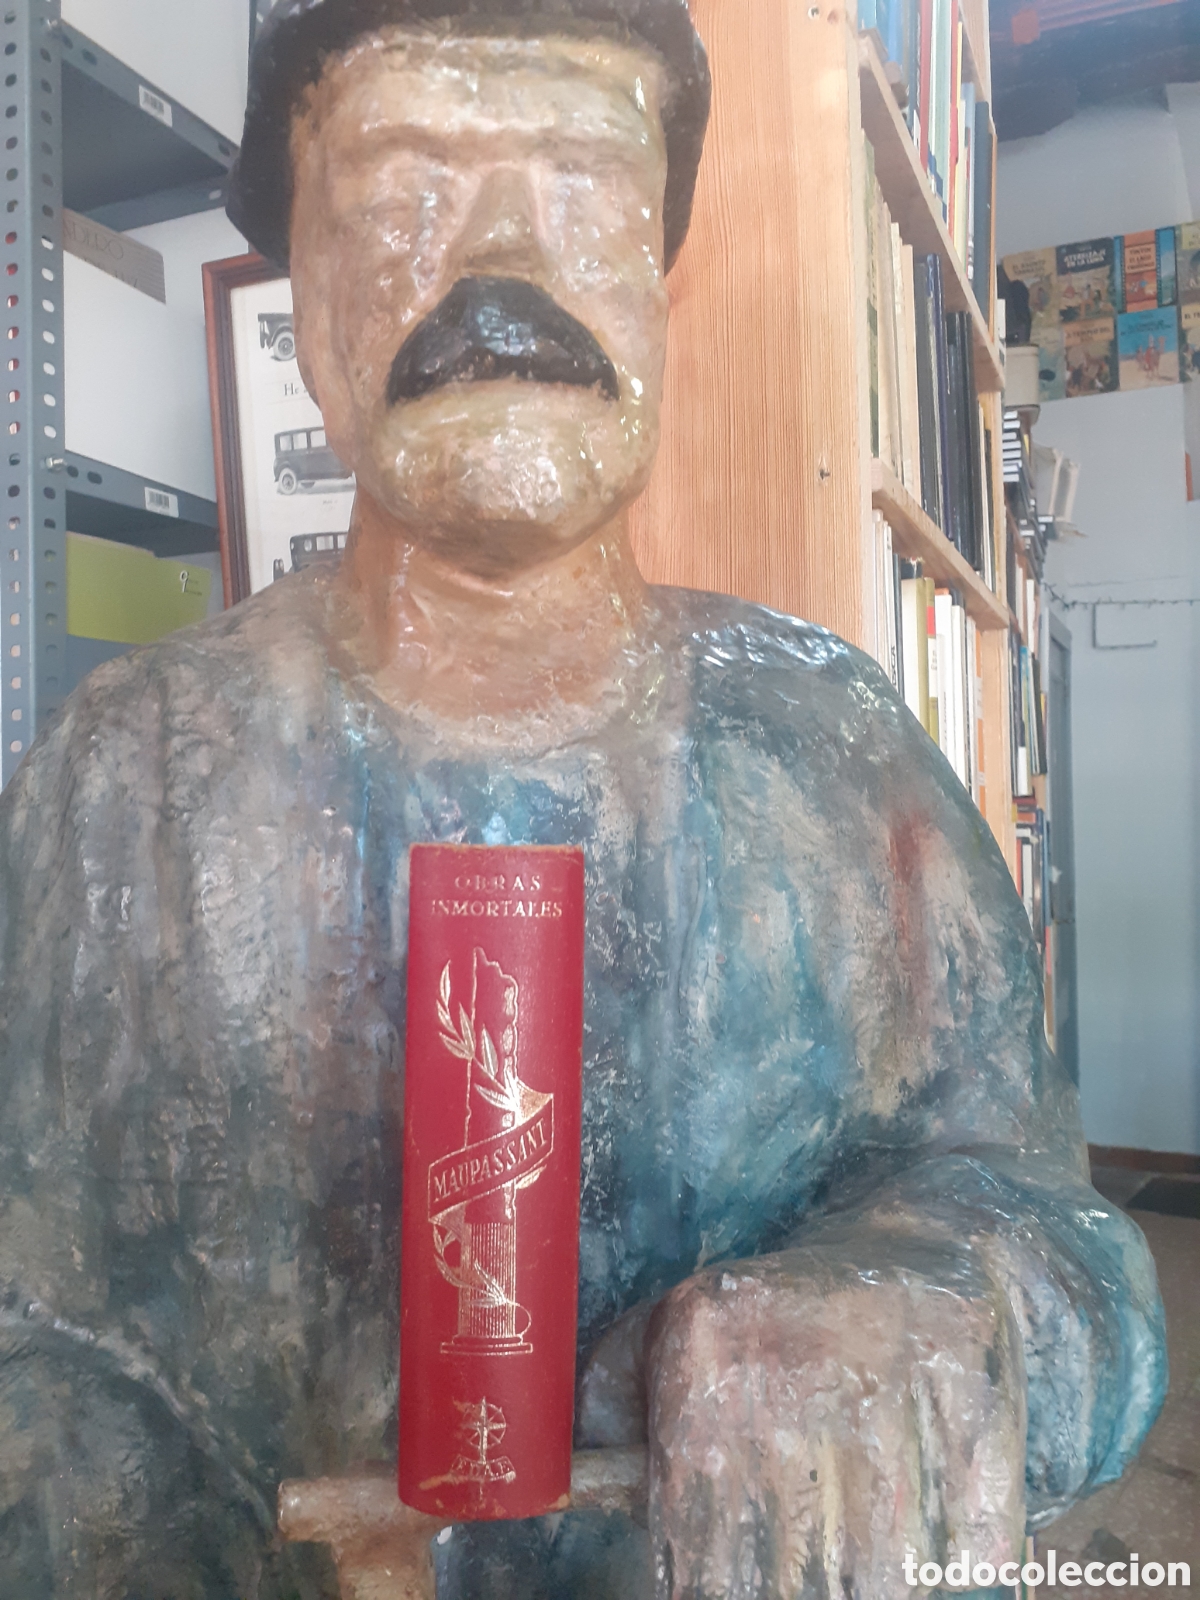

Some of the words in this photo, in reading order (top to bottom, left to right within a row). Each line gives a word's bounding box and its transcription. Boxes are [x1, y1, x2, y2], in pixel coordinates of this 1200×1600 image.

[454, 874, 541, 892] OBRAS
[431, 899, 563, 918] INMORTALES
[433, 1117, 548, 1203] MAUPASSANT
